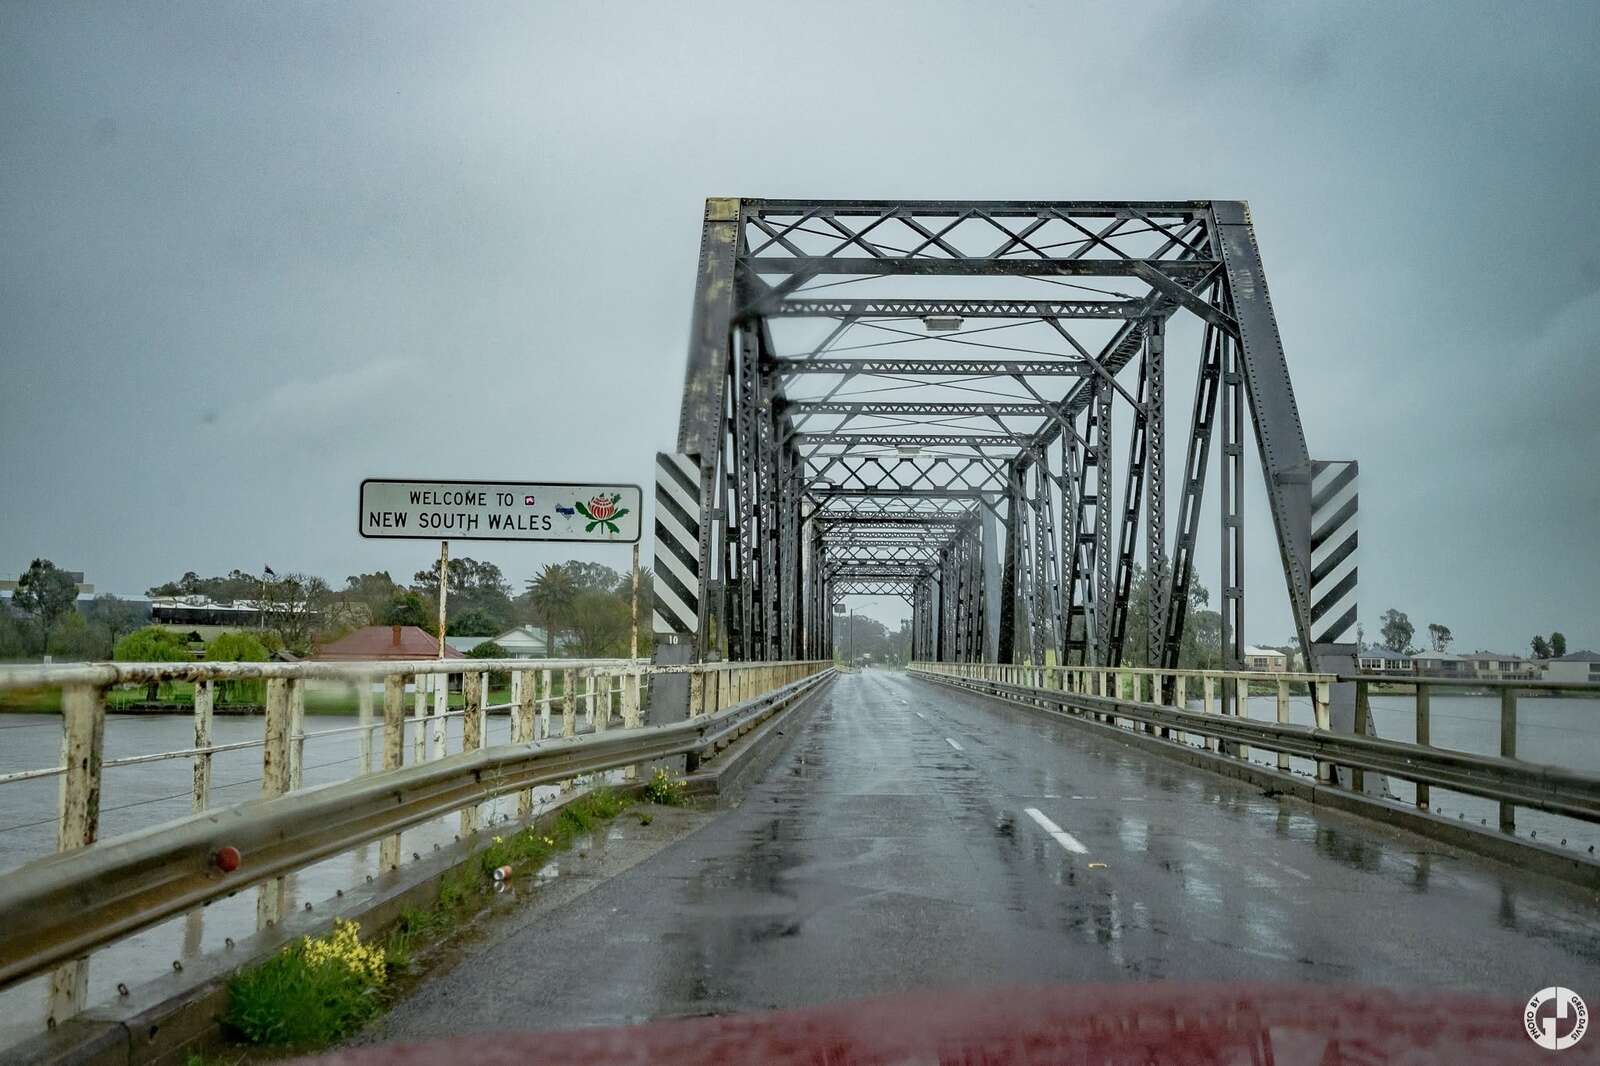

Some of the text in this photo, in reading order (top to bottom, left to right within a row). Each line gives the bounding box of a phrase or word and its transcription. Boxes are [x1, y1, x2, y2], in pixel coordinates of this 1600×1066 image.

[409, 491, 514, 507] WELCOME TO
[369, 511, 552, 531] NEW SOUTH WALES
[669, 634, 678, 645] 10
